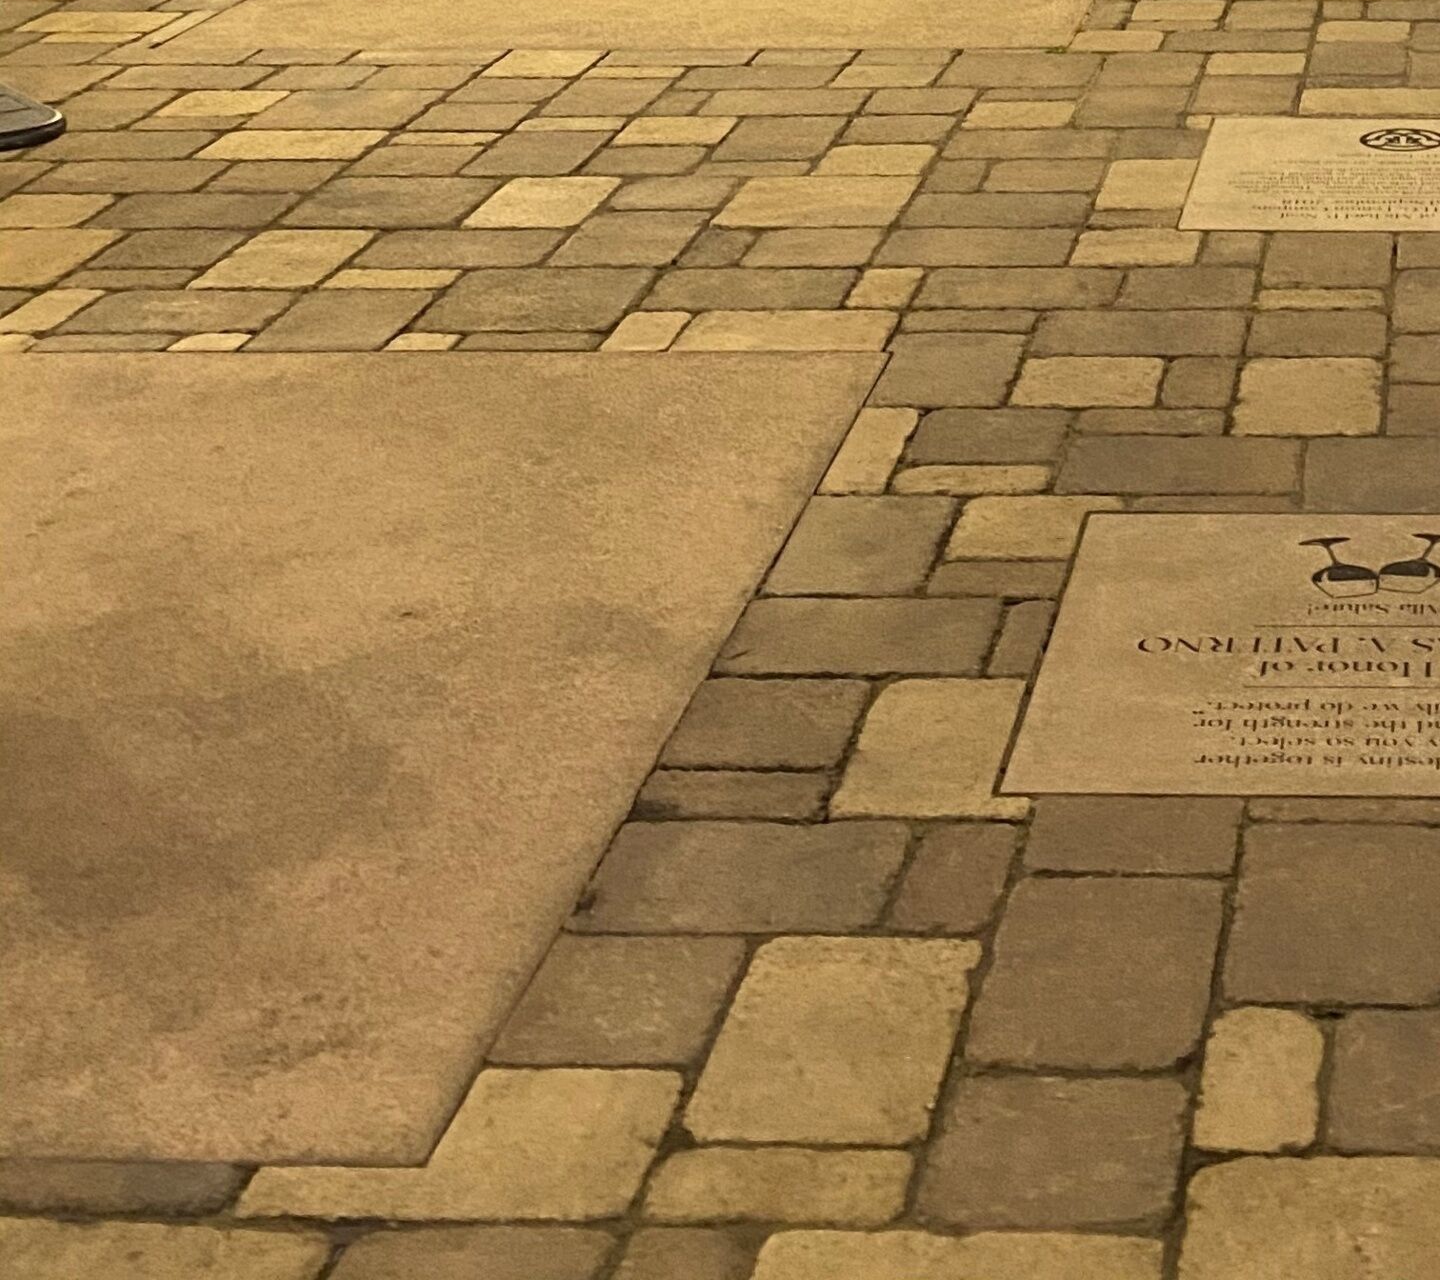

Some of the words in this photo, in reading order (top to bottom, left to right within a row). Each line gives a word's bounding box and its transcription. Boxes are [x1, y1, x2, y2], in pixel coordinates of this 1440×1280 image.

[1136, 636, 1340, 653] PATERNO
[1358, 637, 1395, 653] A.
[1257, 661, 1294, 676] of
[1307, 661, 1433, 678] Honor
[1320, 702, 1353, 714] do
[1362, 703, 1400, 712] we
[1193, 718, 1233, 731] for
[1243, 717, 1354, 732] strength
[1364, 720, 1406, 733] the
[1326, 738, 1355, 746] so
[1365, 738, 1416, 747] you
[1193, 753, 1312, 768] together
[1323, 756, 1343, 767] is
